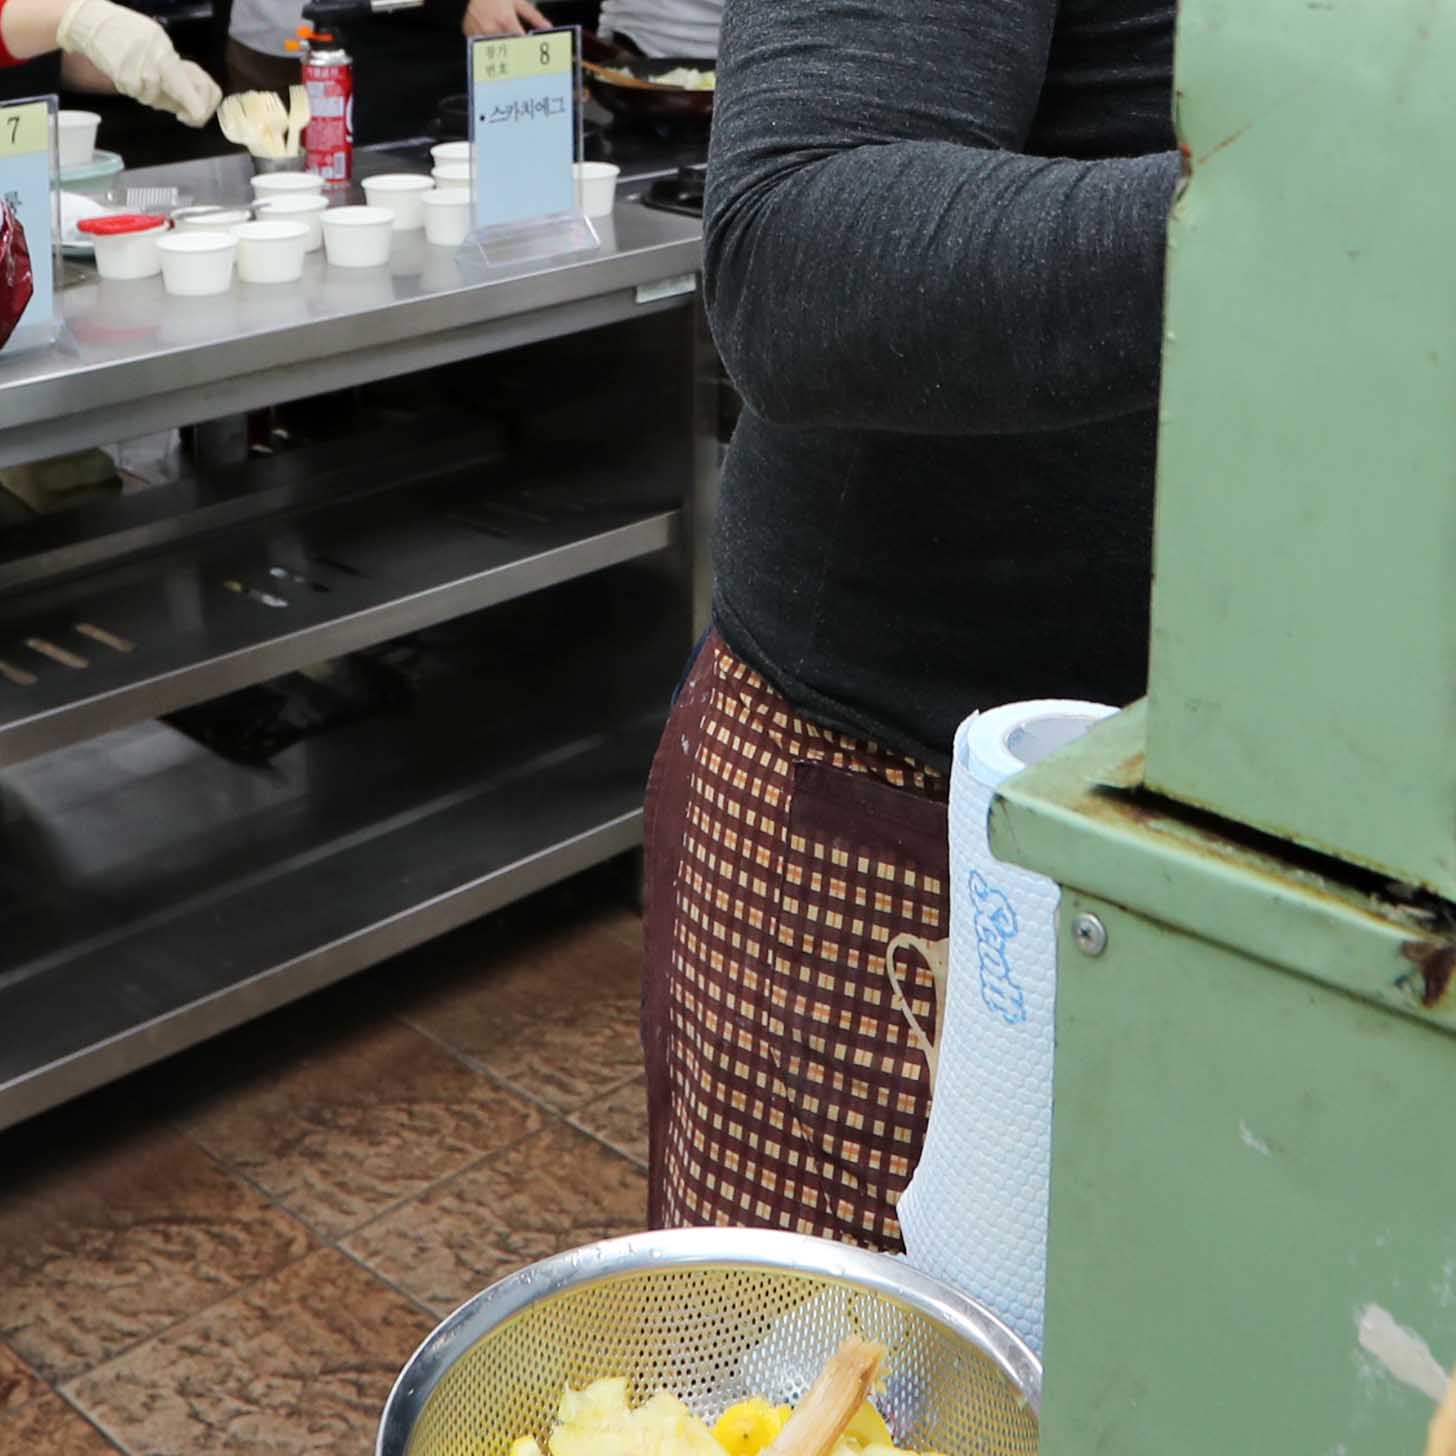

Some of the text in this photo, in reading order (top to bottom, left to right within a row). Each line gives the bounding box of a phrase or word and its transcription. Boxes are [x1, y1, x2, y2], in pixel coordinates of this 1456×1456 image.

[539, 41, 550, 65] 8
[7, 116, 20, 145] 7
[968, 869, 1026, 1024] Scott
